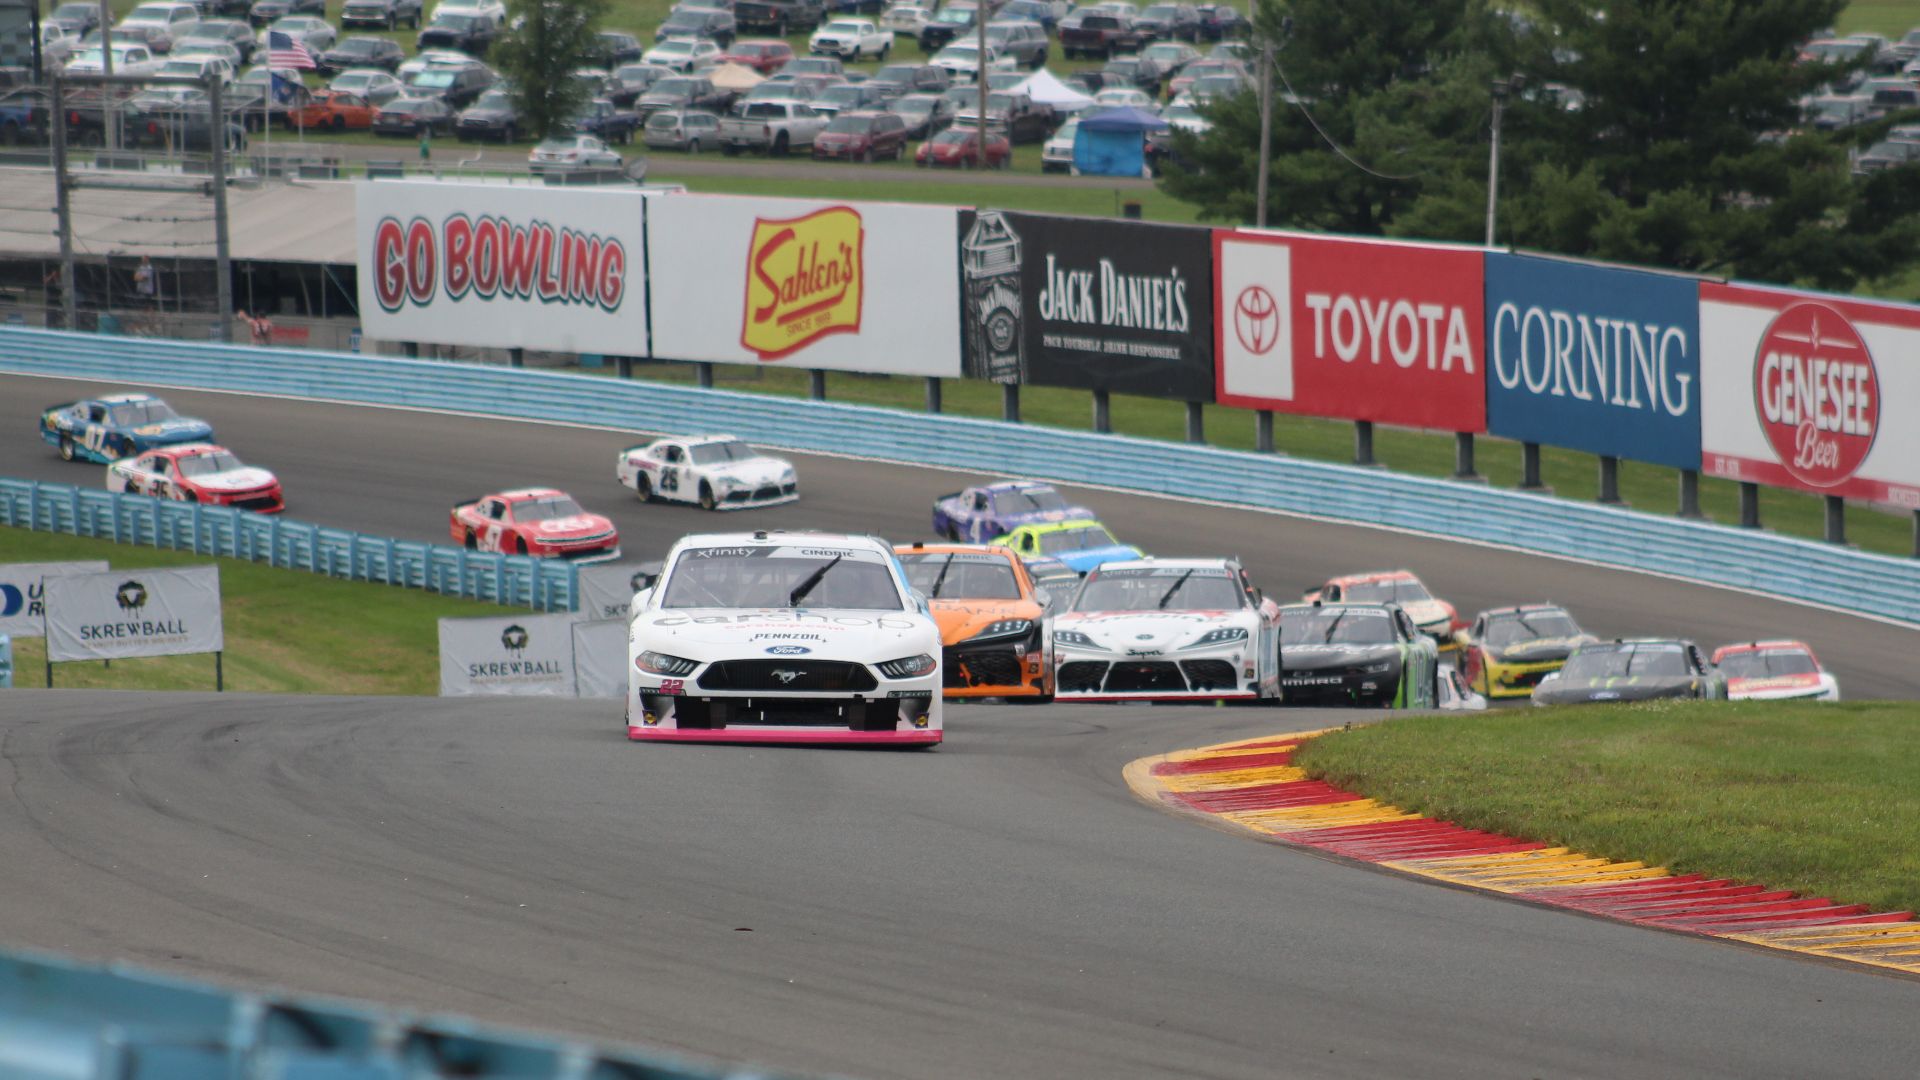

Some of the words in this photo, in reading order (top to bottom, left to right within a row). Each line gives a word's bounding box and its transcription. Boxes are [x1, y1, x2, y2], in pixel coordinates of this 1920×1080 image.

[373, 215, 437, 313] GO
[442, 212, 626, 313] BOWLING
[754, 228, 853, 325] Sahlen's
[1039, 253, 1096, 324] JACK
[1099, 258, 1189, 333] DANIEL'S
[1305, 293, 1475, 374] TOYOTA
[1493, 302, 1691, 417] CORNING
[1760, 350, 1871, 437] GENESEE
[1793, 420, 1840, 470] Beer
[696, 547, 757, 558] xfinity
[801, 549, 855, 558] CINDRIC
[80, 619, 188, 640] SKREWBALL
[652, 611, 915, 630] carshop
[754, 632, 823, 641] PENNZOIL
[771, 645, 803, 655] Ford
[1126, 649, 1165, 660] Supra
[469, 660, 563, 678] SKREWBALL
[659, 679, 684, 695] 22
